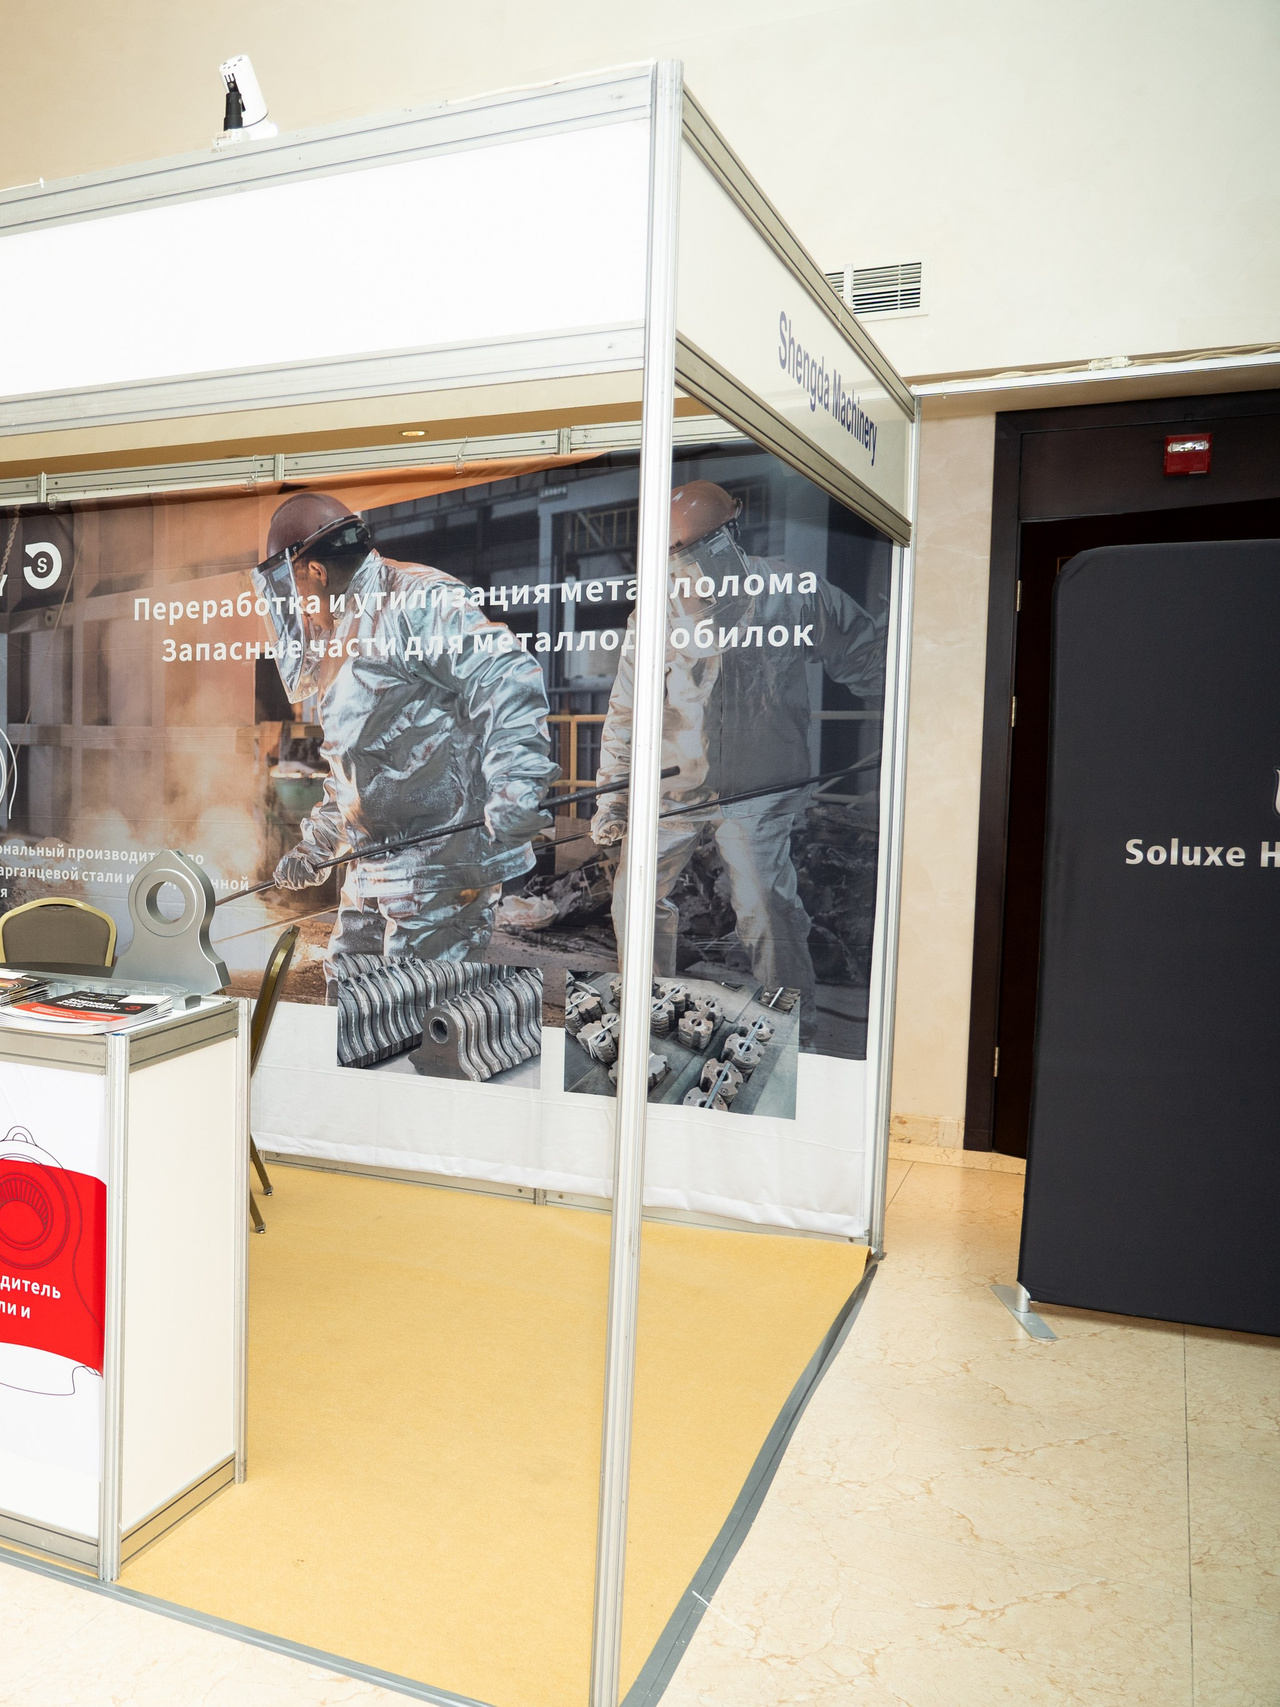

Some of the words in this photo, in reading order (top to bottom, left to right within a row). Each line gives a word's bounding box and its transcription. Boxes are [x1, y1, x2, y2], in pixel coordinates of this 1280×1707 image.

[778, 311, 830, 412] Shengda
[832, 369, 878, 466] Machinery
[133, 591, 321, 626] Переработка
[329, 594, 345, 613] и
[353, 583, 551, 619] утилизация
[561, 570, 818, 604] металолома
[161, 639, 302, 663] Запасные
[308, 634, 396, 659] части
[404, 633, 464, 661] для
[473, 618, 814, 657] металлодобилок
[68, 848, 160, 865] производит
[1125, 837, 1246, 868] Soluxe
[82, 870, 123, 884] стали
[21, 1304, 31, 1319] и
